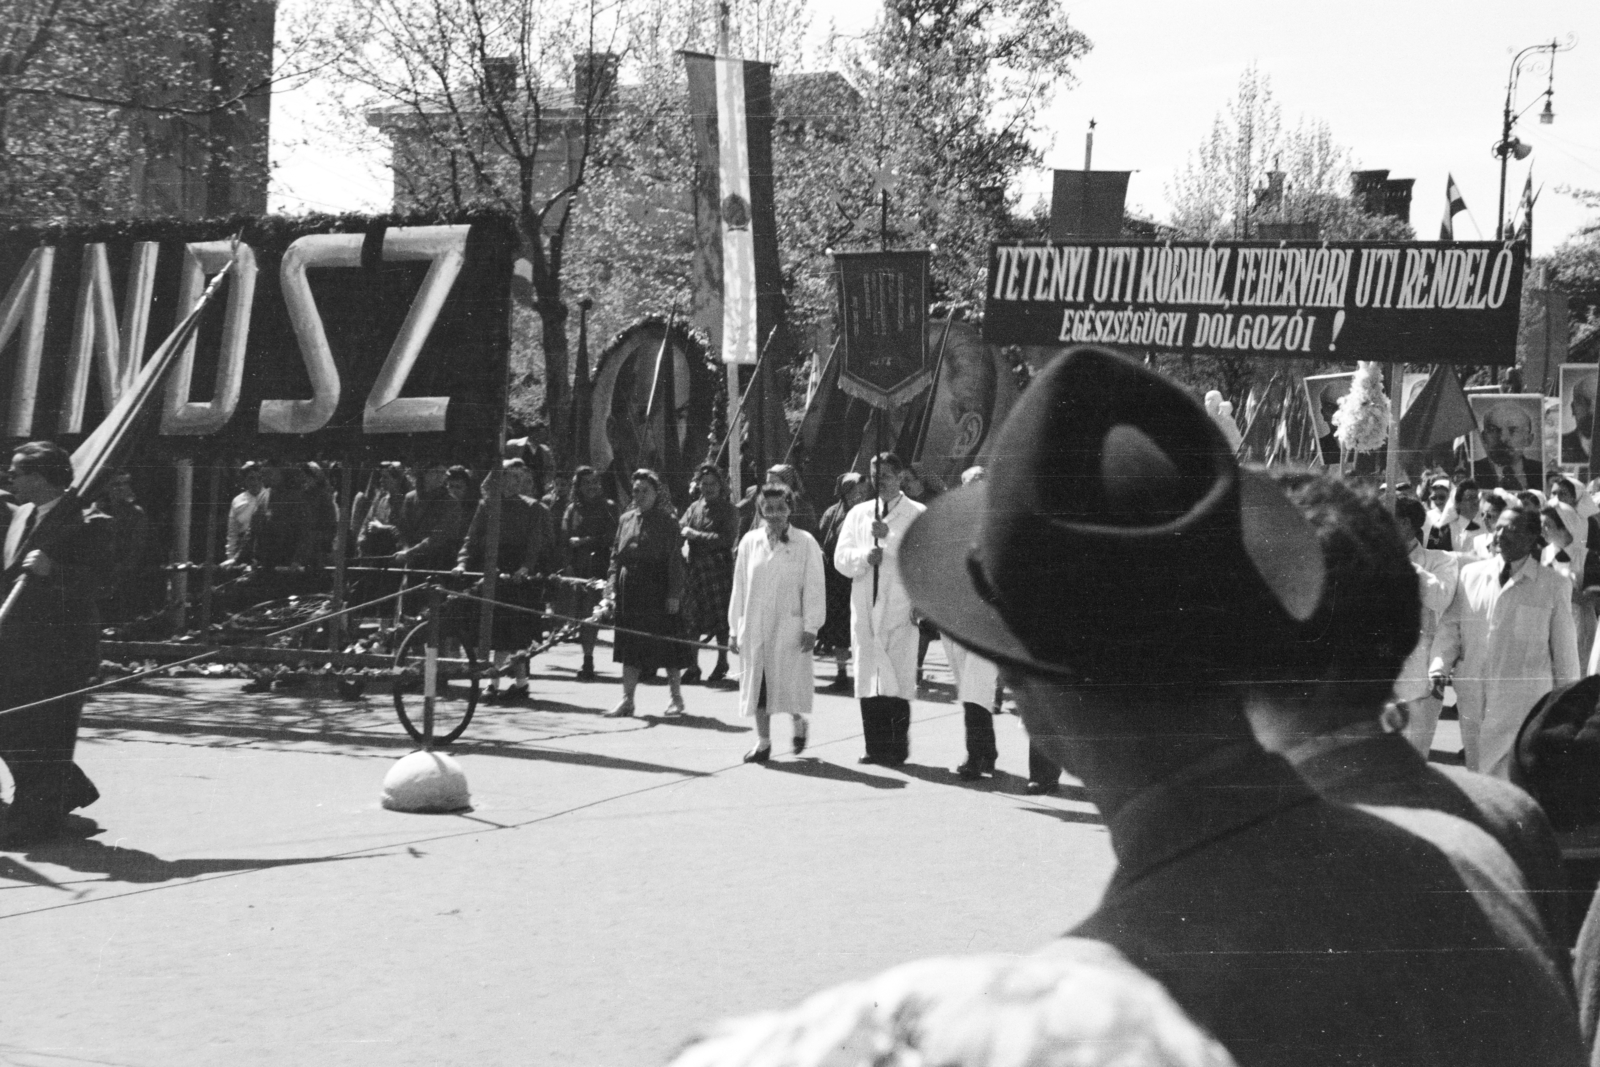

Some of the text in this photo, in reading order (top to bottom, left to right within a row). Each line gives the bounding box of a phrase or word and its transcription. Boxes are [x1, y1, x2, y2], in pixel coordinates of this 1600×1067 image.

[993, 239, 1514, 310] TÉTÉNYI UTI KÓRHÁZ, FEHÉRVÁRI UTI RENDELŐ
[1058, 304, 1187, 347] EGÉSZSÉGÜGYI
[1192, 309, 1317, 352] DOLGOZÓI
